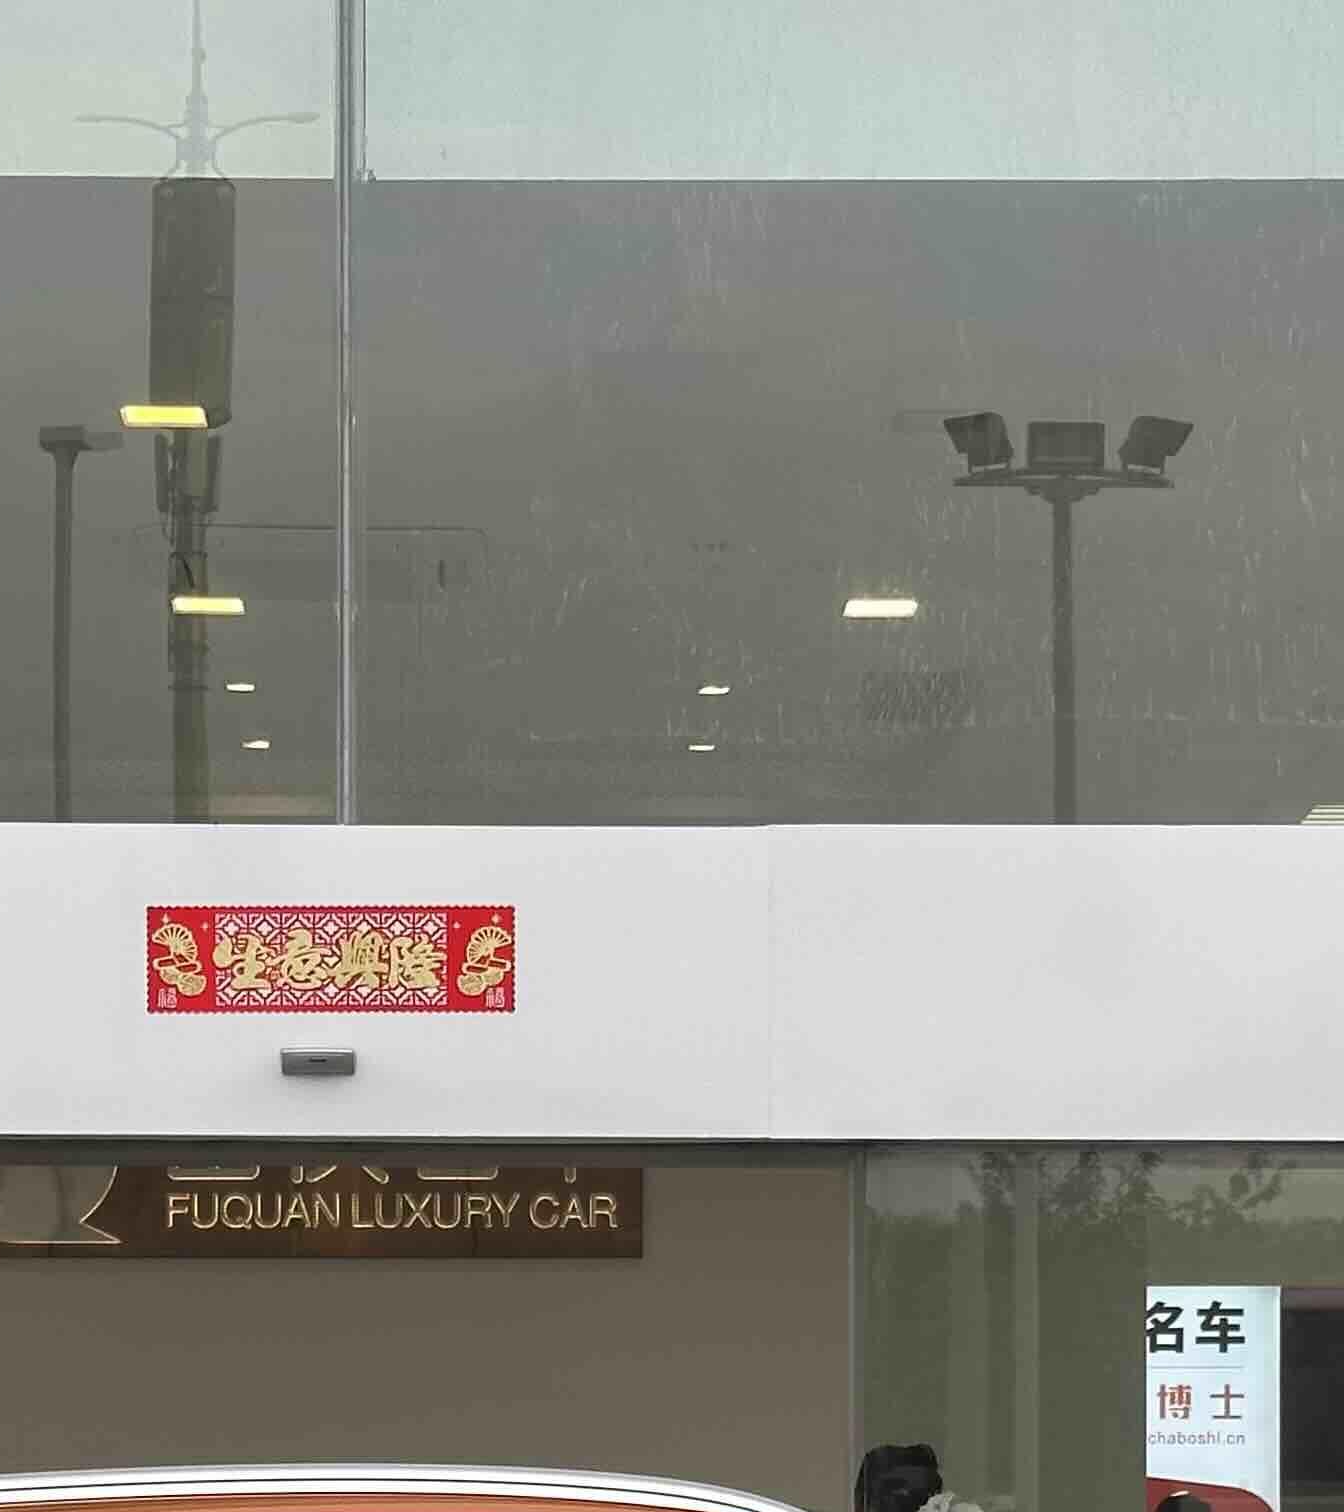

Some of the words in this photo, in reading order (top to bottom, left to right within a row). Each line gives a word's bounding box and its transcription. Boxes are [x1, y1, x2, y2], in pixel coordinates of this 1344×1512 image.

[167, 1192, 341, 1231] FUQUAN
[350, 1192, 521, 1230] LUXURY
[528, 1195, 619, 1230] CAR
[1146, 1300, 1246, 1353] 名车
[1156, 1383, 1245, 1420] 博士
